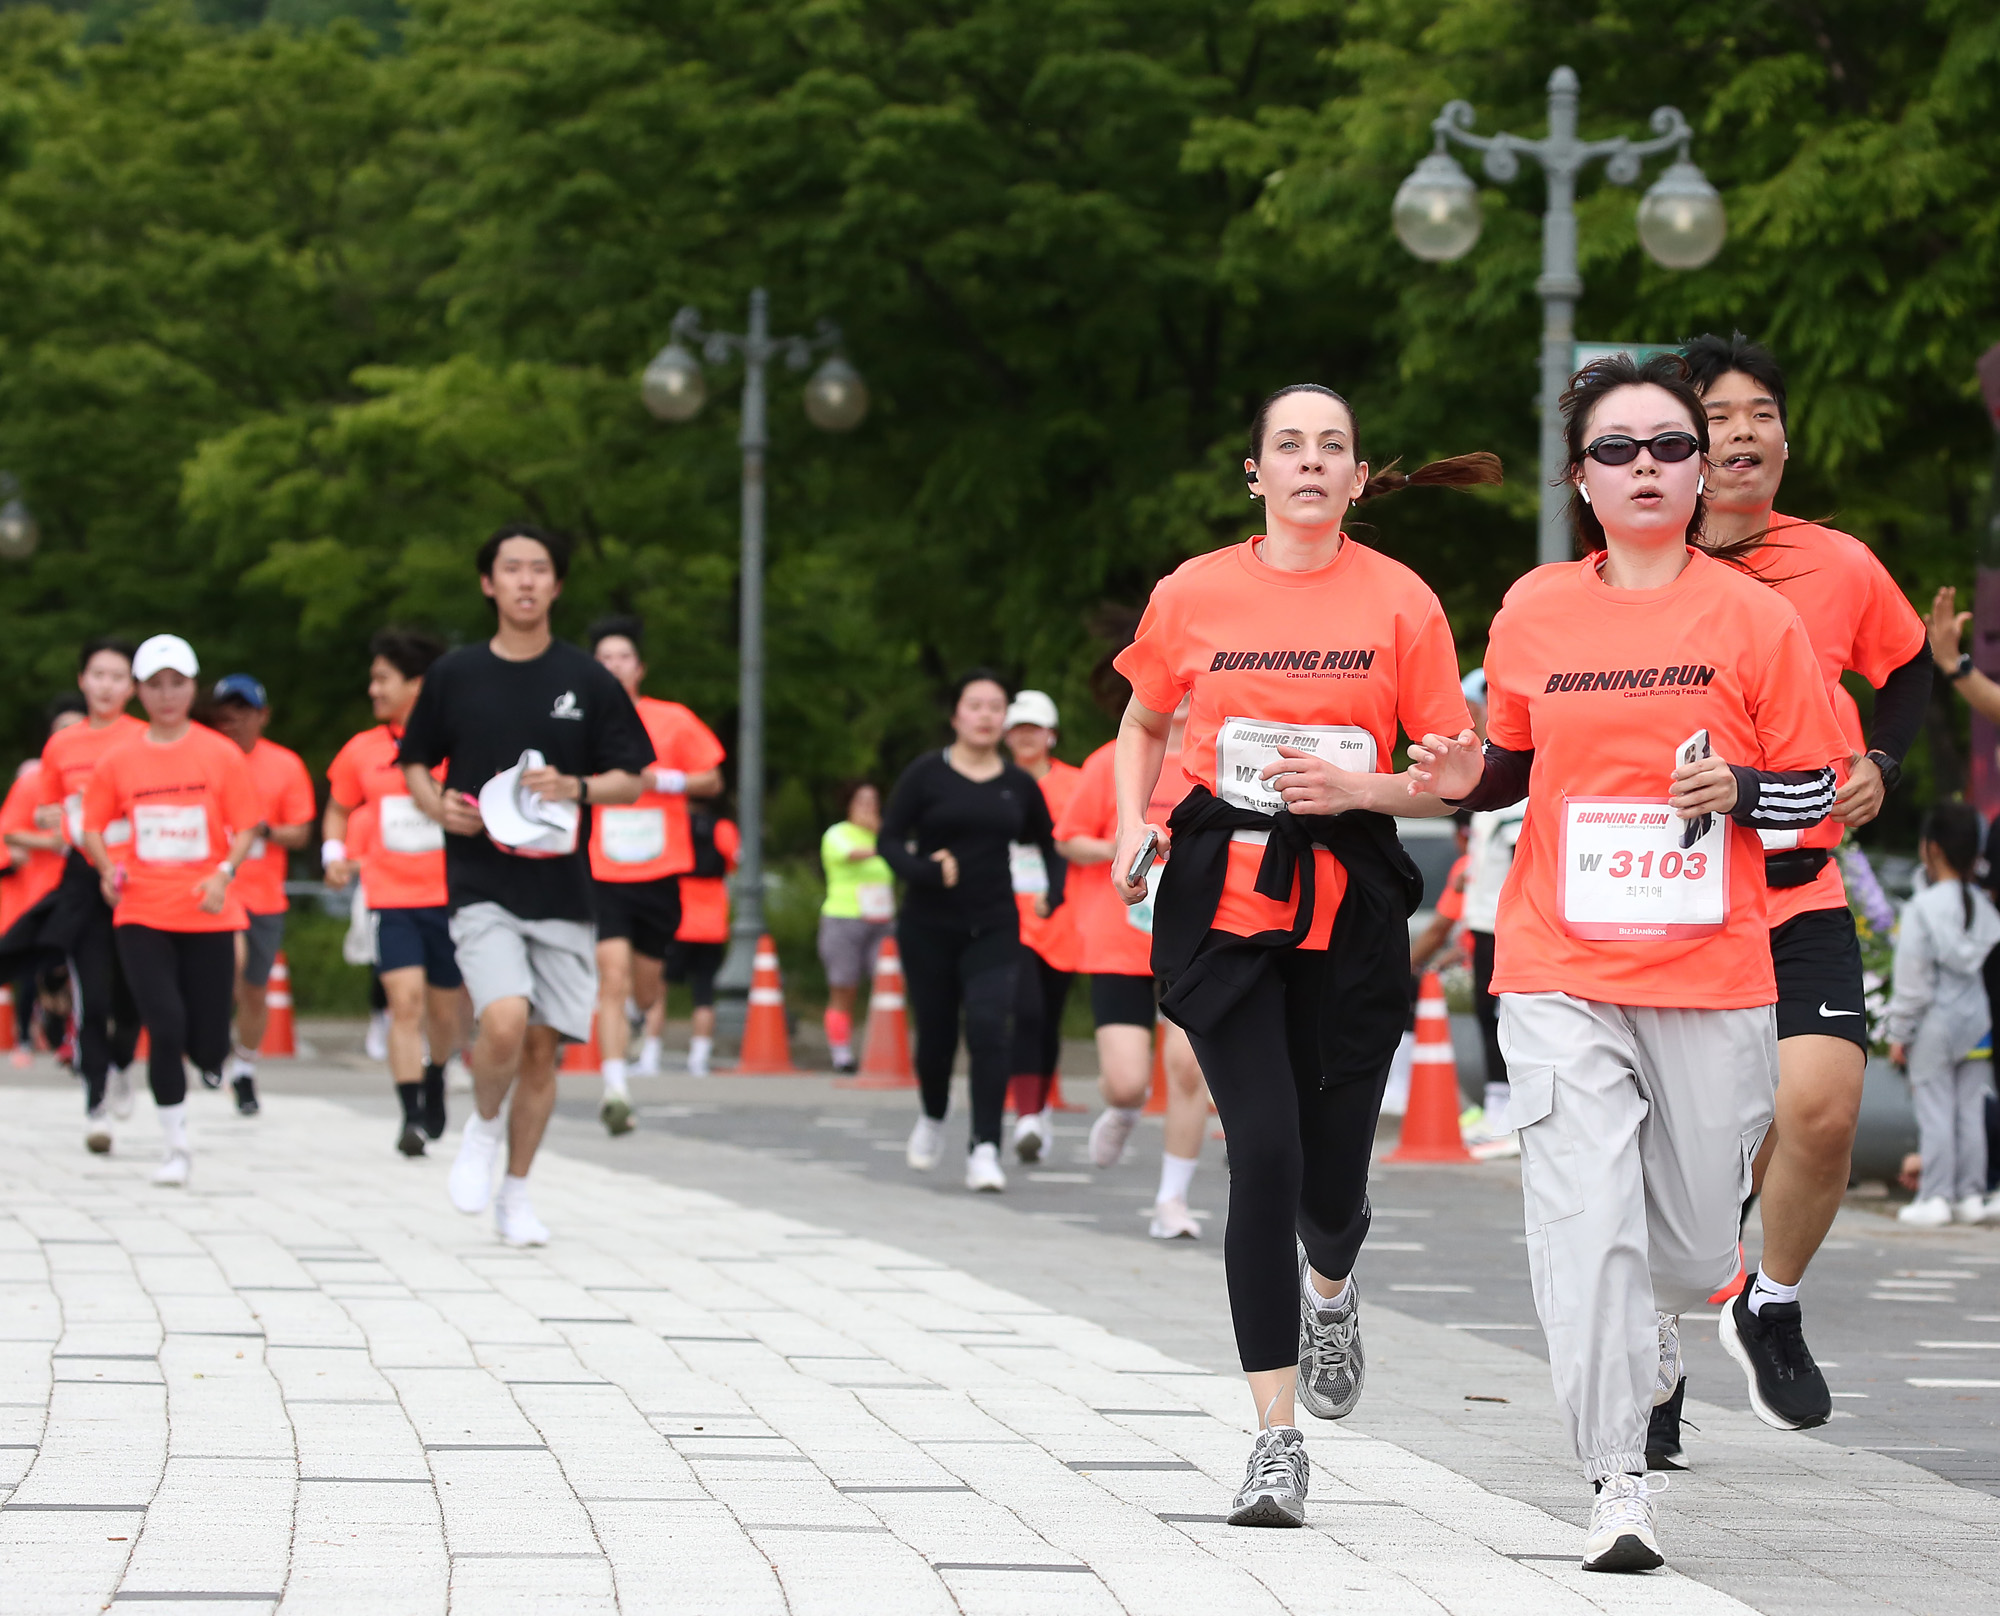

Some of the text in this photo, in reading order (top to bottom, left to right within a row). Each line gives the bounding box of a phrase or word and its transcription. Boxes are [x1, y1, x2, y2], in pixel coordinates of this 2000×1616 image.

[1209, 650, 1375, 672] BURNING RUN
[1312, 672, 1341, 680] Running
[1342, 672, 1369, 680] Festival
[1544, 665, 1716, 694] BURNING RUN
[1624, 690, 1648, 698] Casual
[1650, 689, 1680, 697] Running
[1232, 729, 1320, 748] BURNING RUN
[1339, 740, 1363, 750] 5km
[1235, 765, 1258, 783] W
[1576, 812, 1670, 825] BURNING RUN
[1579, 850, 1708, 880] W 3103
[1625, 885, 1662, 898] 최지애
